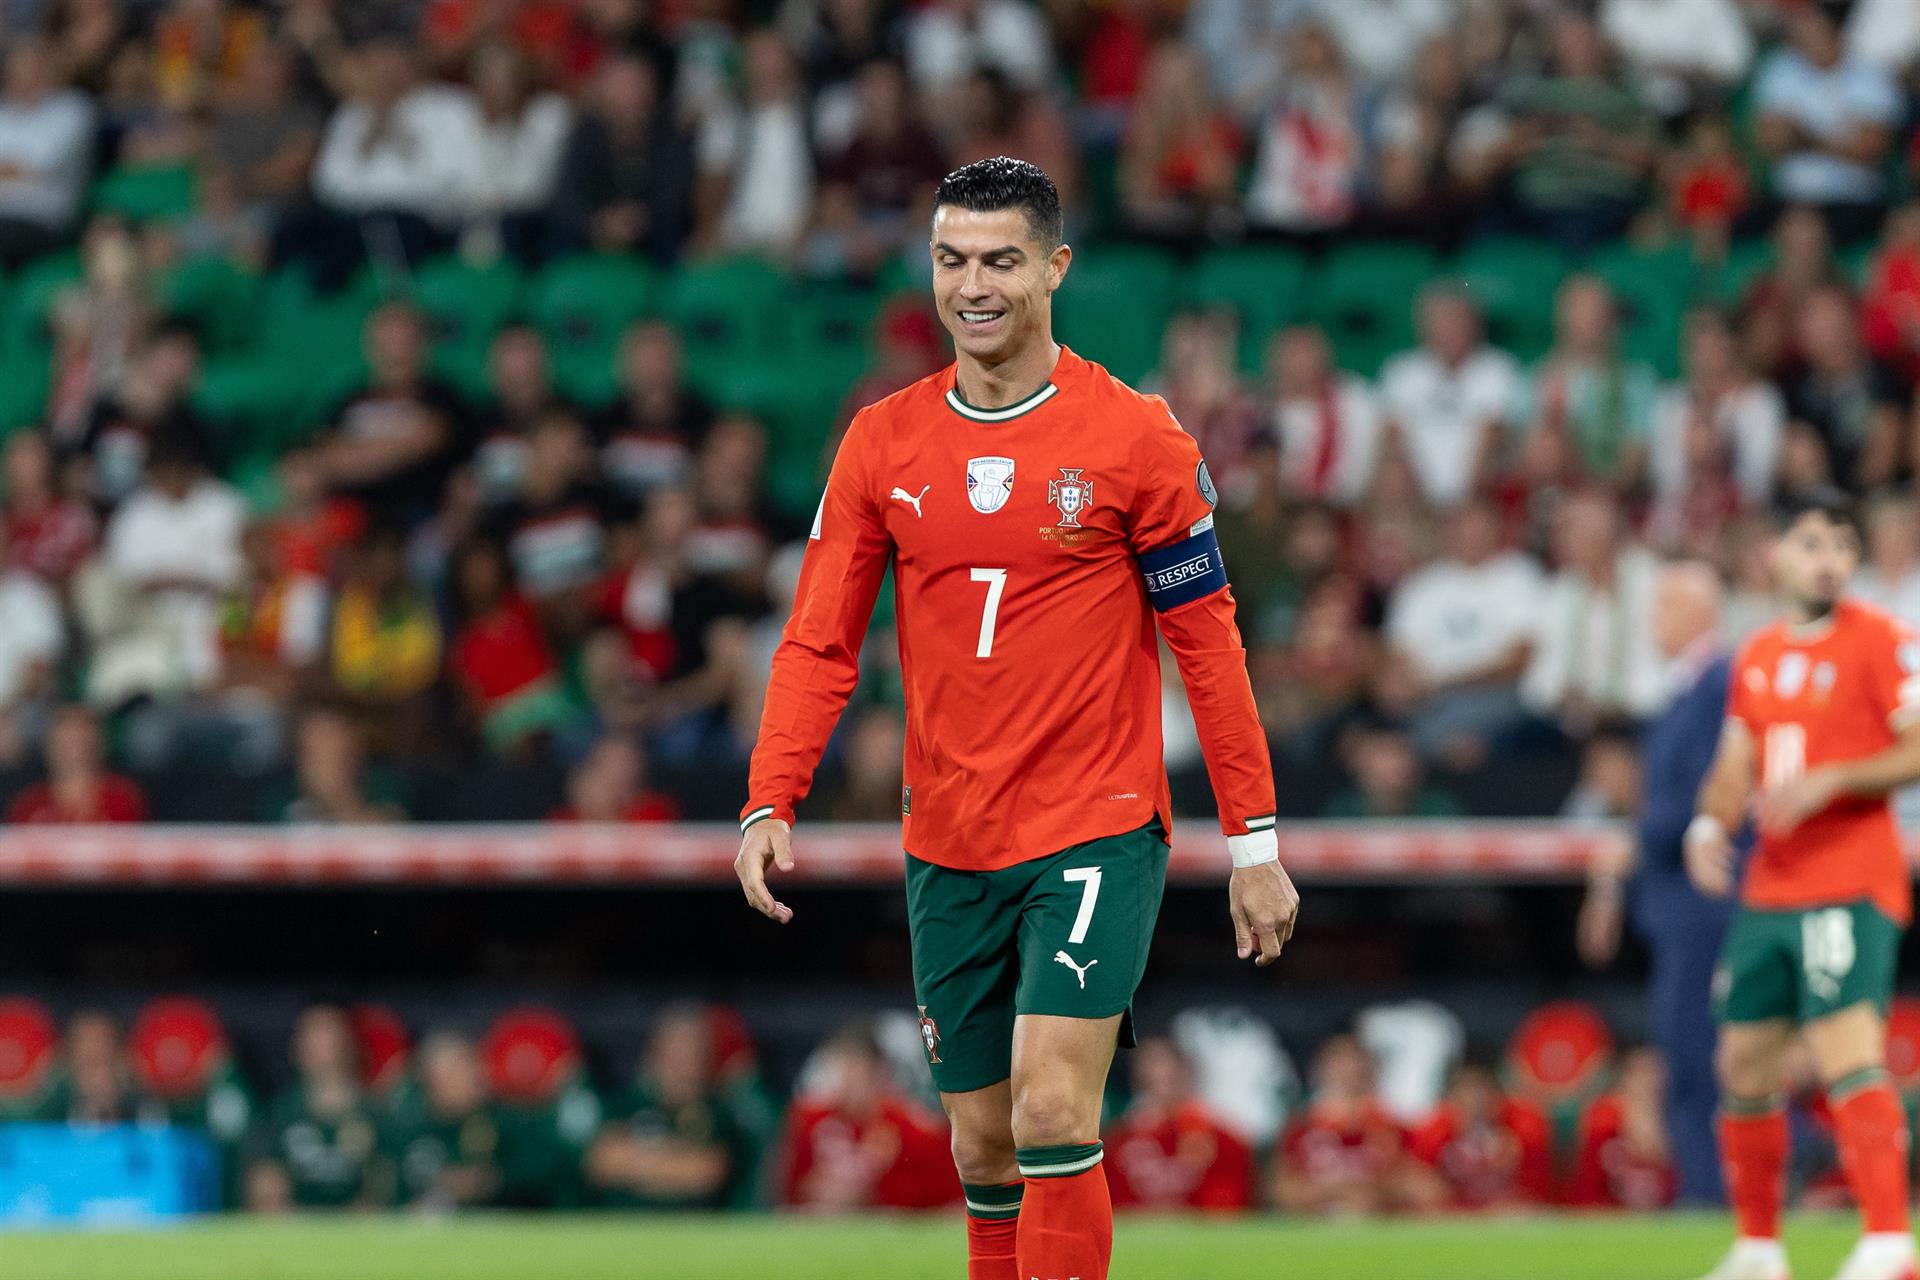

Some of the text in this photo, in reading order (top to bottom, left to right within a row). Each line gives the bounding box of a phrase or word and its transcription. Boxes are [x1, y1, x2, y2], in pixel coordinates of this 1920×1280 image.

[1157, 557, 1210, 586] RESPECT
[970, 567, 1008, 658] 7
[1063, 866, 1102, 944] 7
